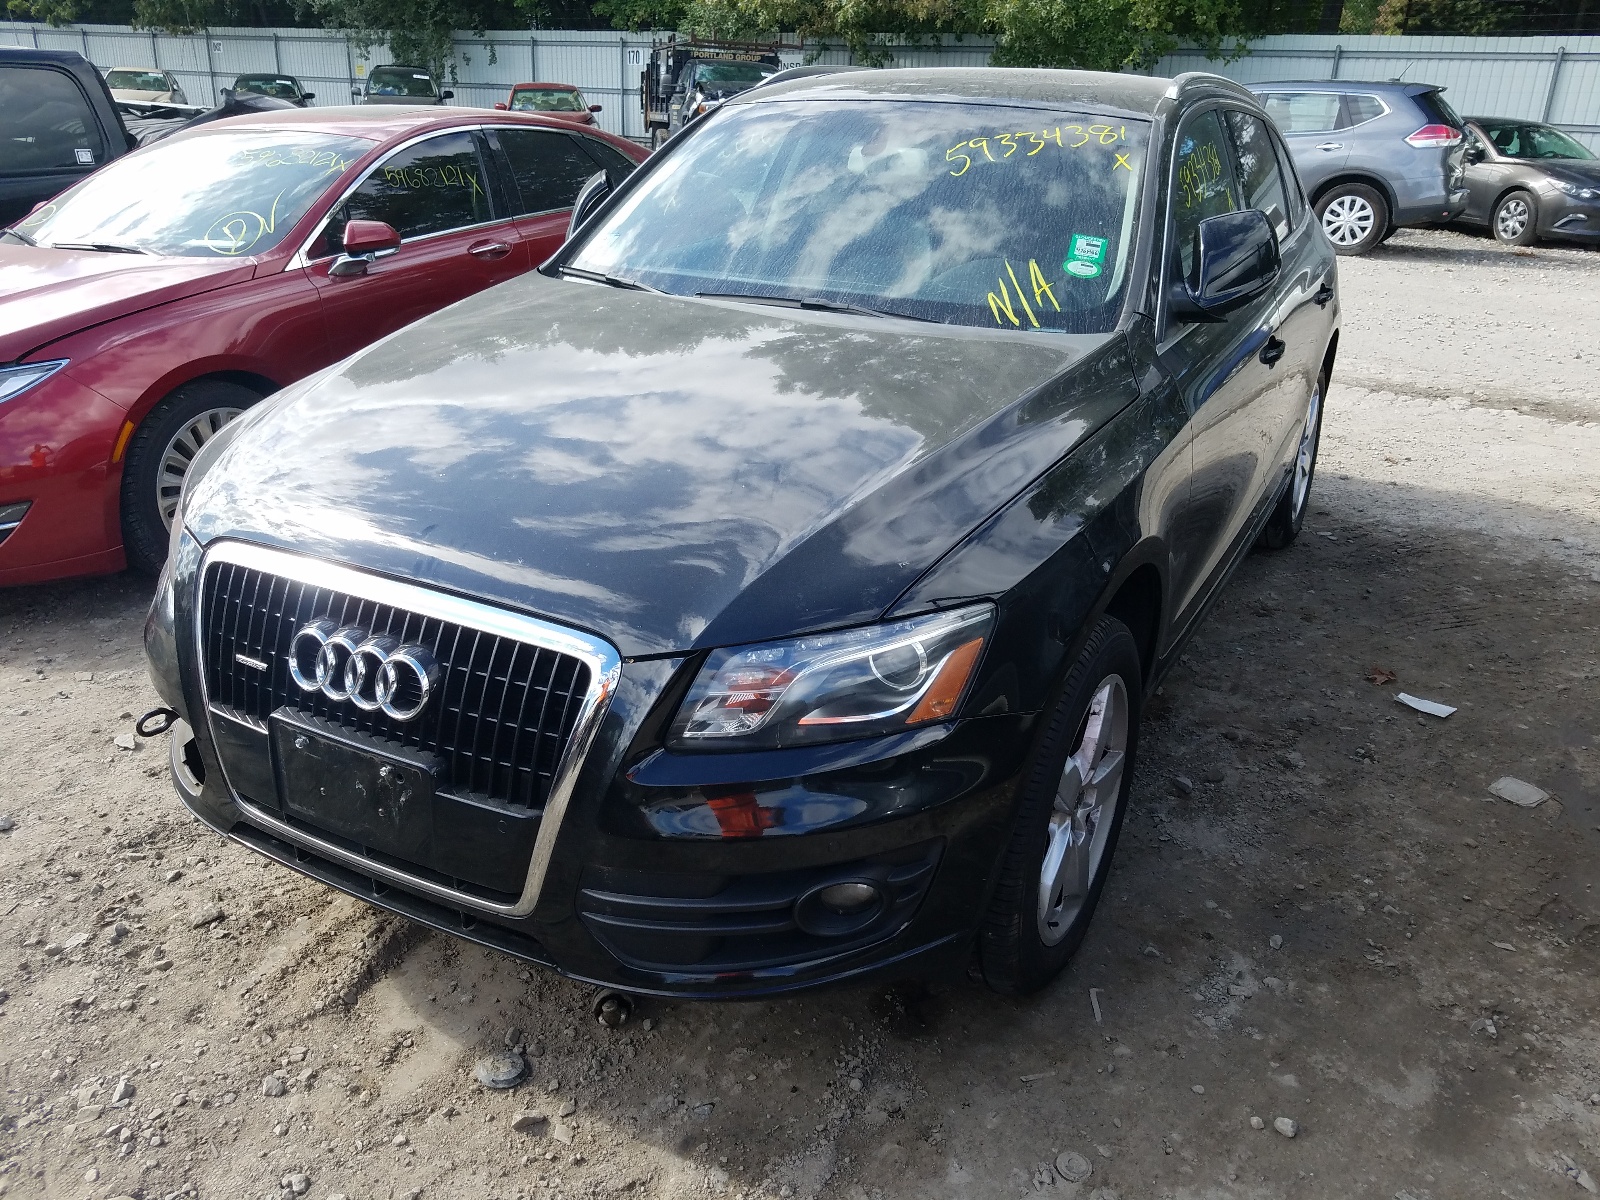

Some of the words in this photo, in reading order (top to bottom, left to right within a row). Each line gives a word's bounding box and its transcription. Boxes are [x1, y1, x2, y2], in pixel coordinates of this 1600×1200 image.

[628, 50, 640, 65] 170
[693, 51, 734, 60] PORTLAND
[735, 54, 762, 62] GROUP
[946, 125, 1126, 176] 59334381
[987, 257, 1060, 328] N/A
